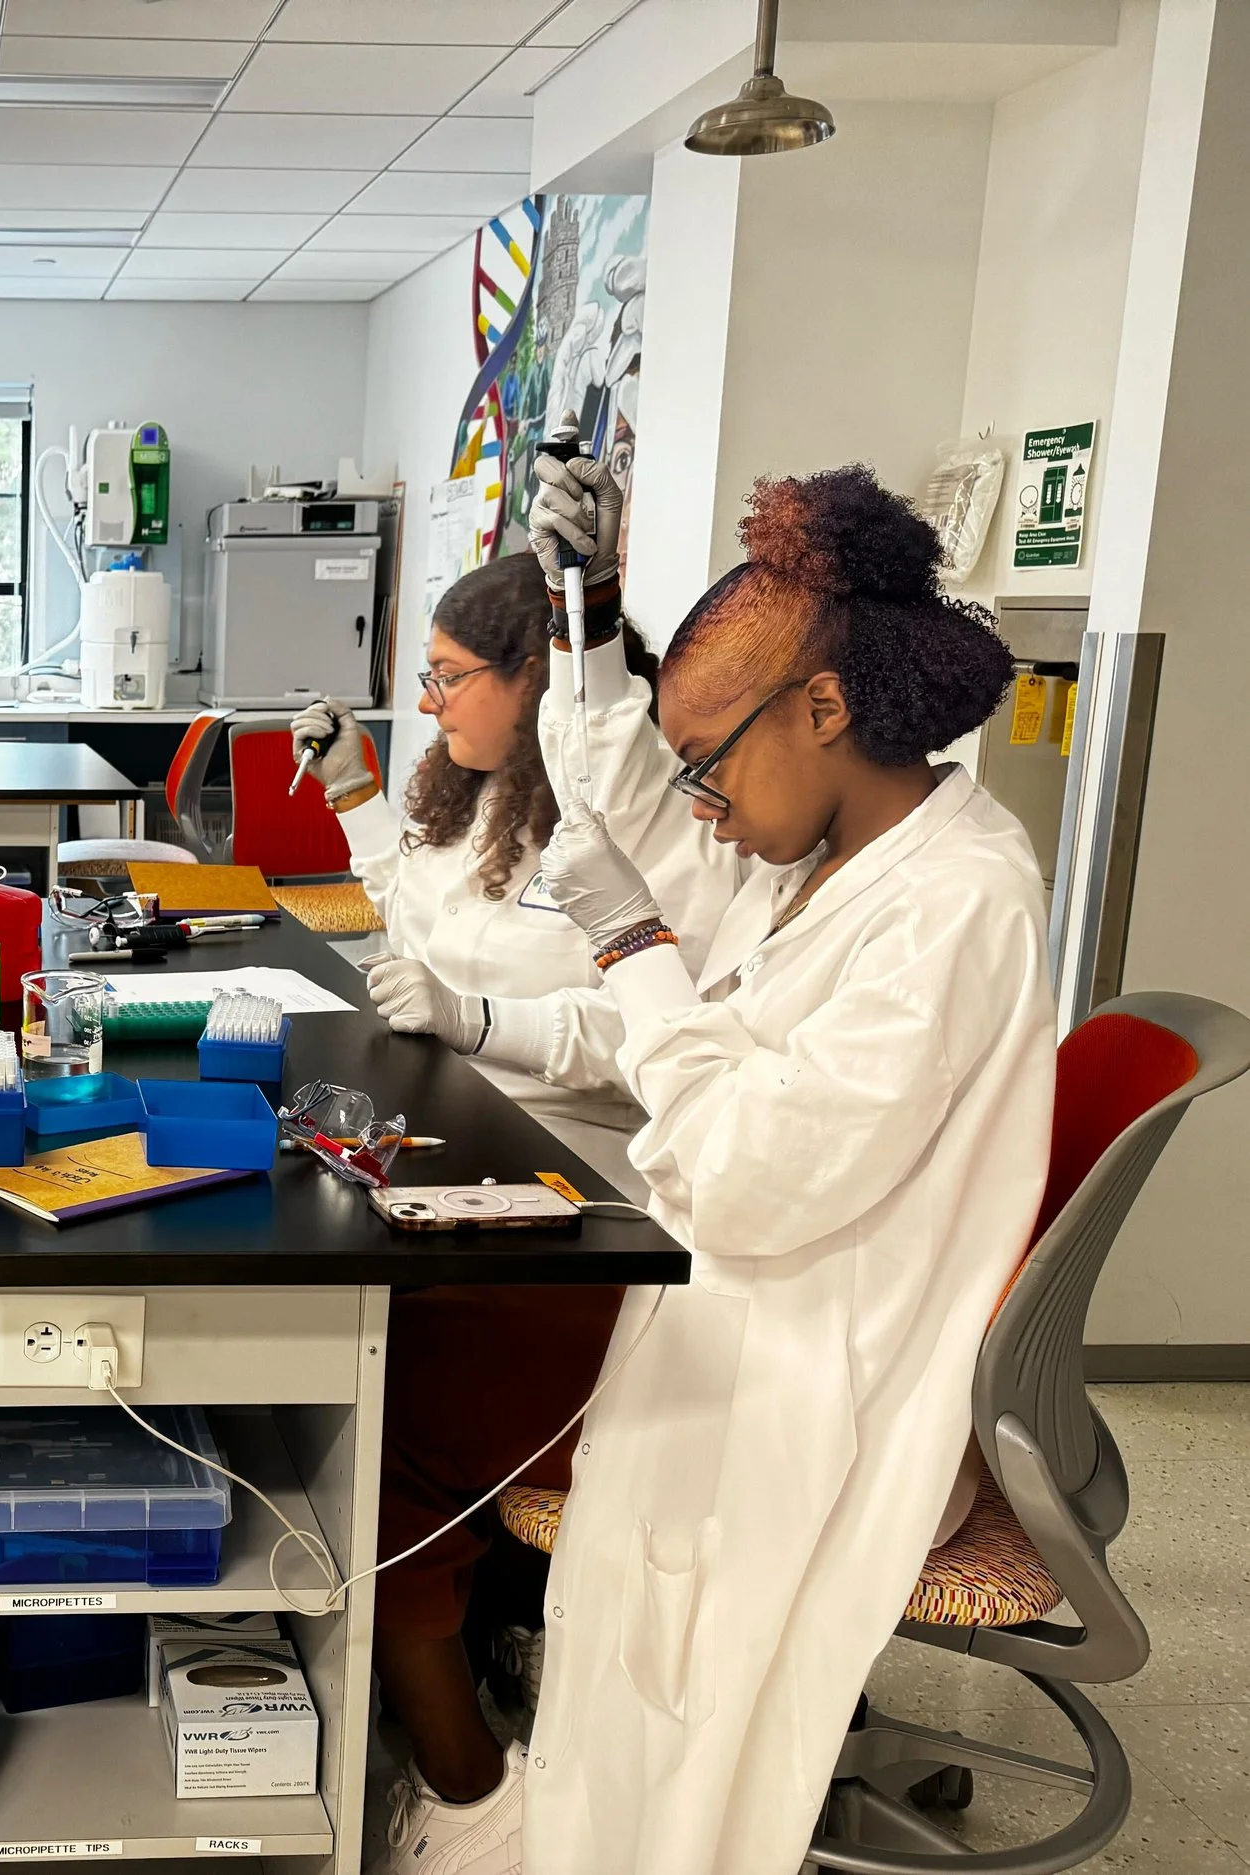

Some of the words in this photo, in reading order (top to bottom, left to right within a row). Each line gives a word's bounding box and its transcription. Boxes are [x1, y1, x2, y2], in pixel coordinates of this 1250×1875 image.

[1028, 436, 1065, 447] Emergency
[1027, 444, 1080, 458] Shower/Eyewash
[12, 1597, 103, 1607] MICROPIPETTES
[264, 1703, 313, 1712] VWR
[183, 1732, 219, 1741] VWR
[247, 1747, 267, 1755] Wipers
[86, 1843, 110, 1853] TIPS
[208, 1840, 248, 1850] RACKS
